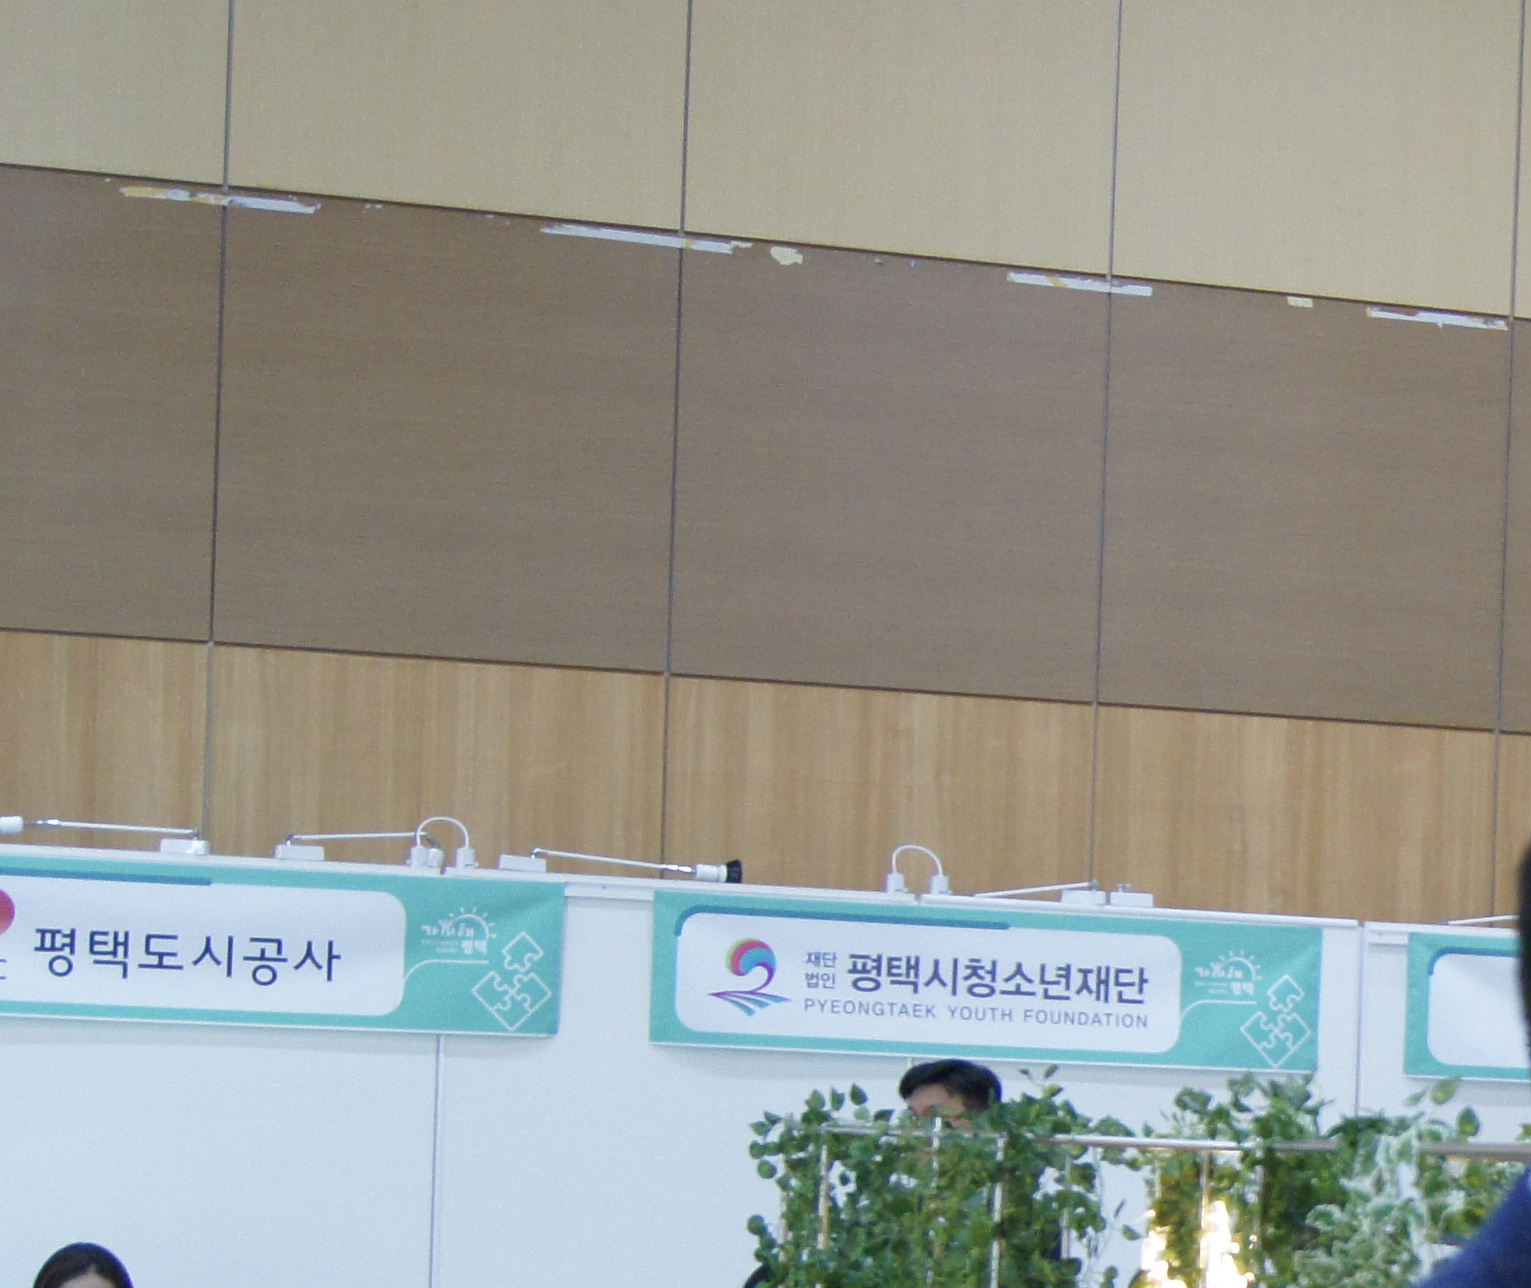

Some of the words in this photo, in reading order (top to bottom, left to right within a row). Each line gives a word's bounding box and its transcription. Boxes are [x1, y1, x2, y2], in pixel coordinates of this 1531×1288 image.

[33, 927, 342, 987] 평택도시공사
[804, 950, 838, 968] 재단
[804, 971, 837, 990] 법인
[847, 952, 1149, 1005] 평택시청소년재단
[804, 998, 937, 1019] PYEONGTAEK
[948, 1005, 1014, 1022] YOUTH
[1023, 1008, 1149, 1029] FOUNDATION
